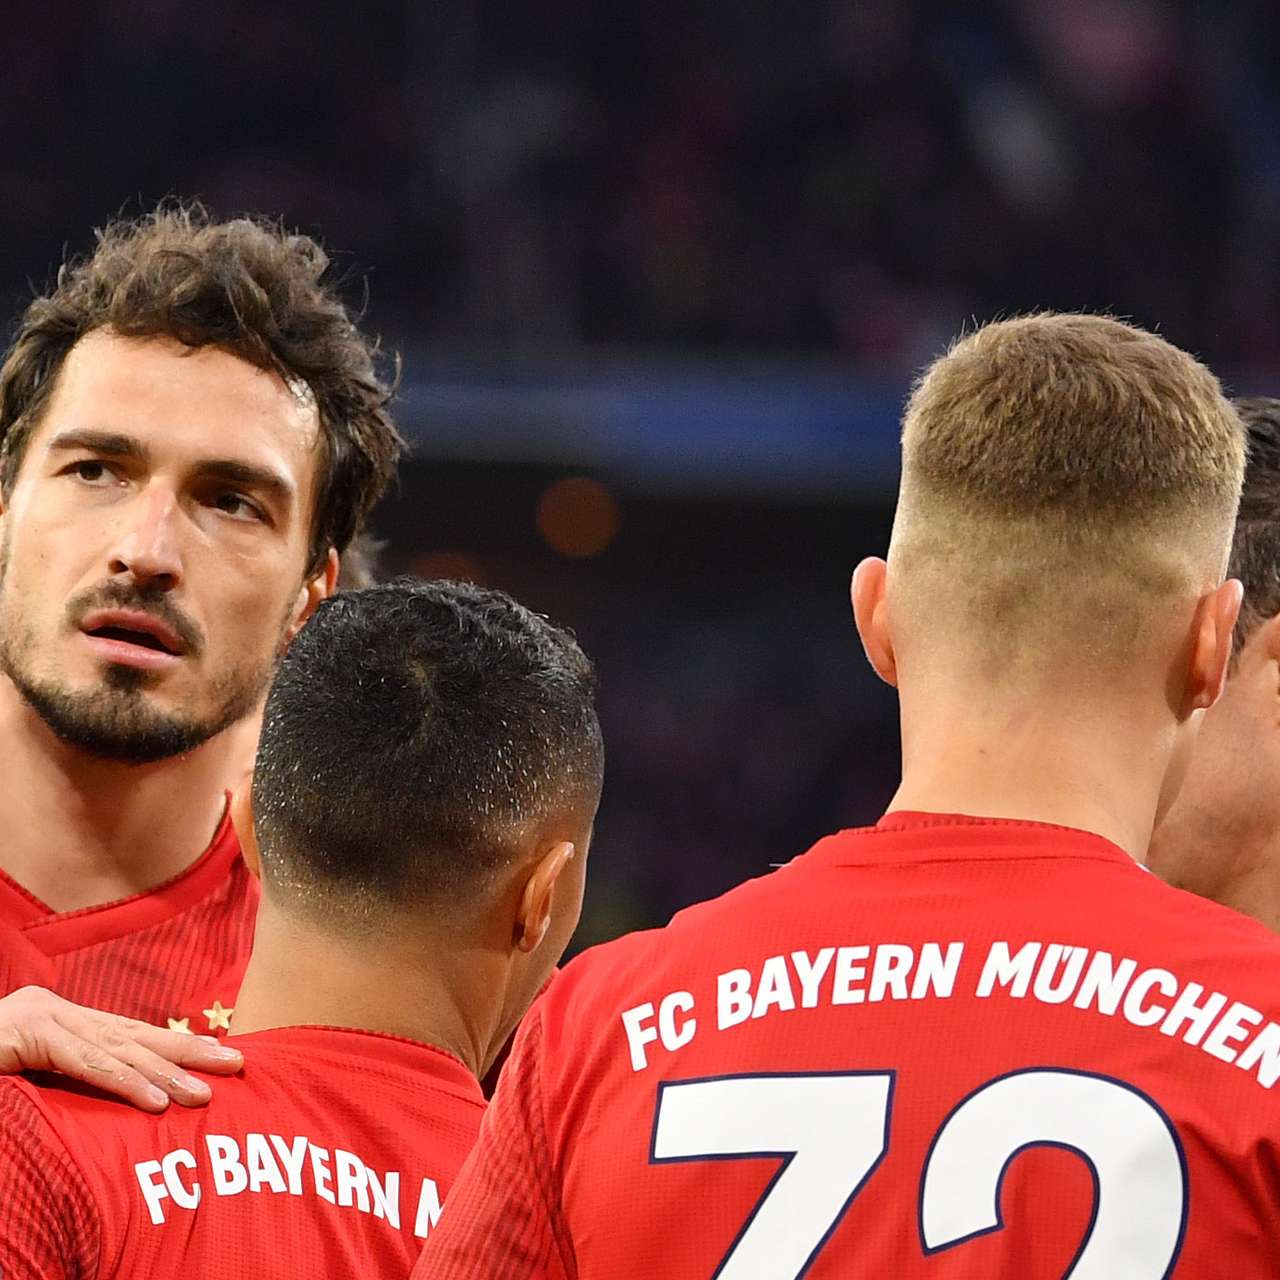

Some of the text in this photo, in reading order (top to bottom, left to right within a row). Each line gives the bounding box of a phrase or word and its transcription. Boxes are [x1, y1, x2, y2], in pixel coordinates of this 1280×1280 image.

[621, 990, 697, 1071] FC
[716, 941, 964, 1031] BAYERN
[134, 1148, 201, 1226] FC
[205, 1133, 401, 1231] BAYERN
